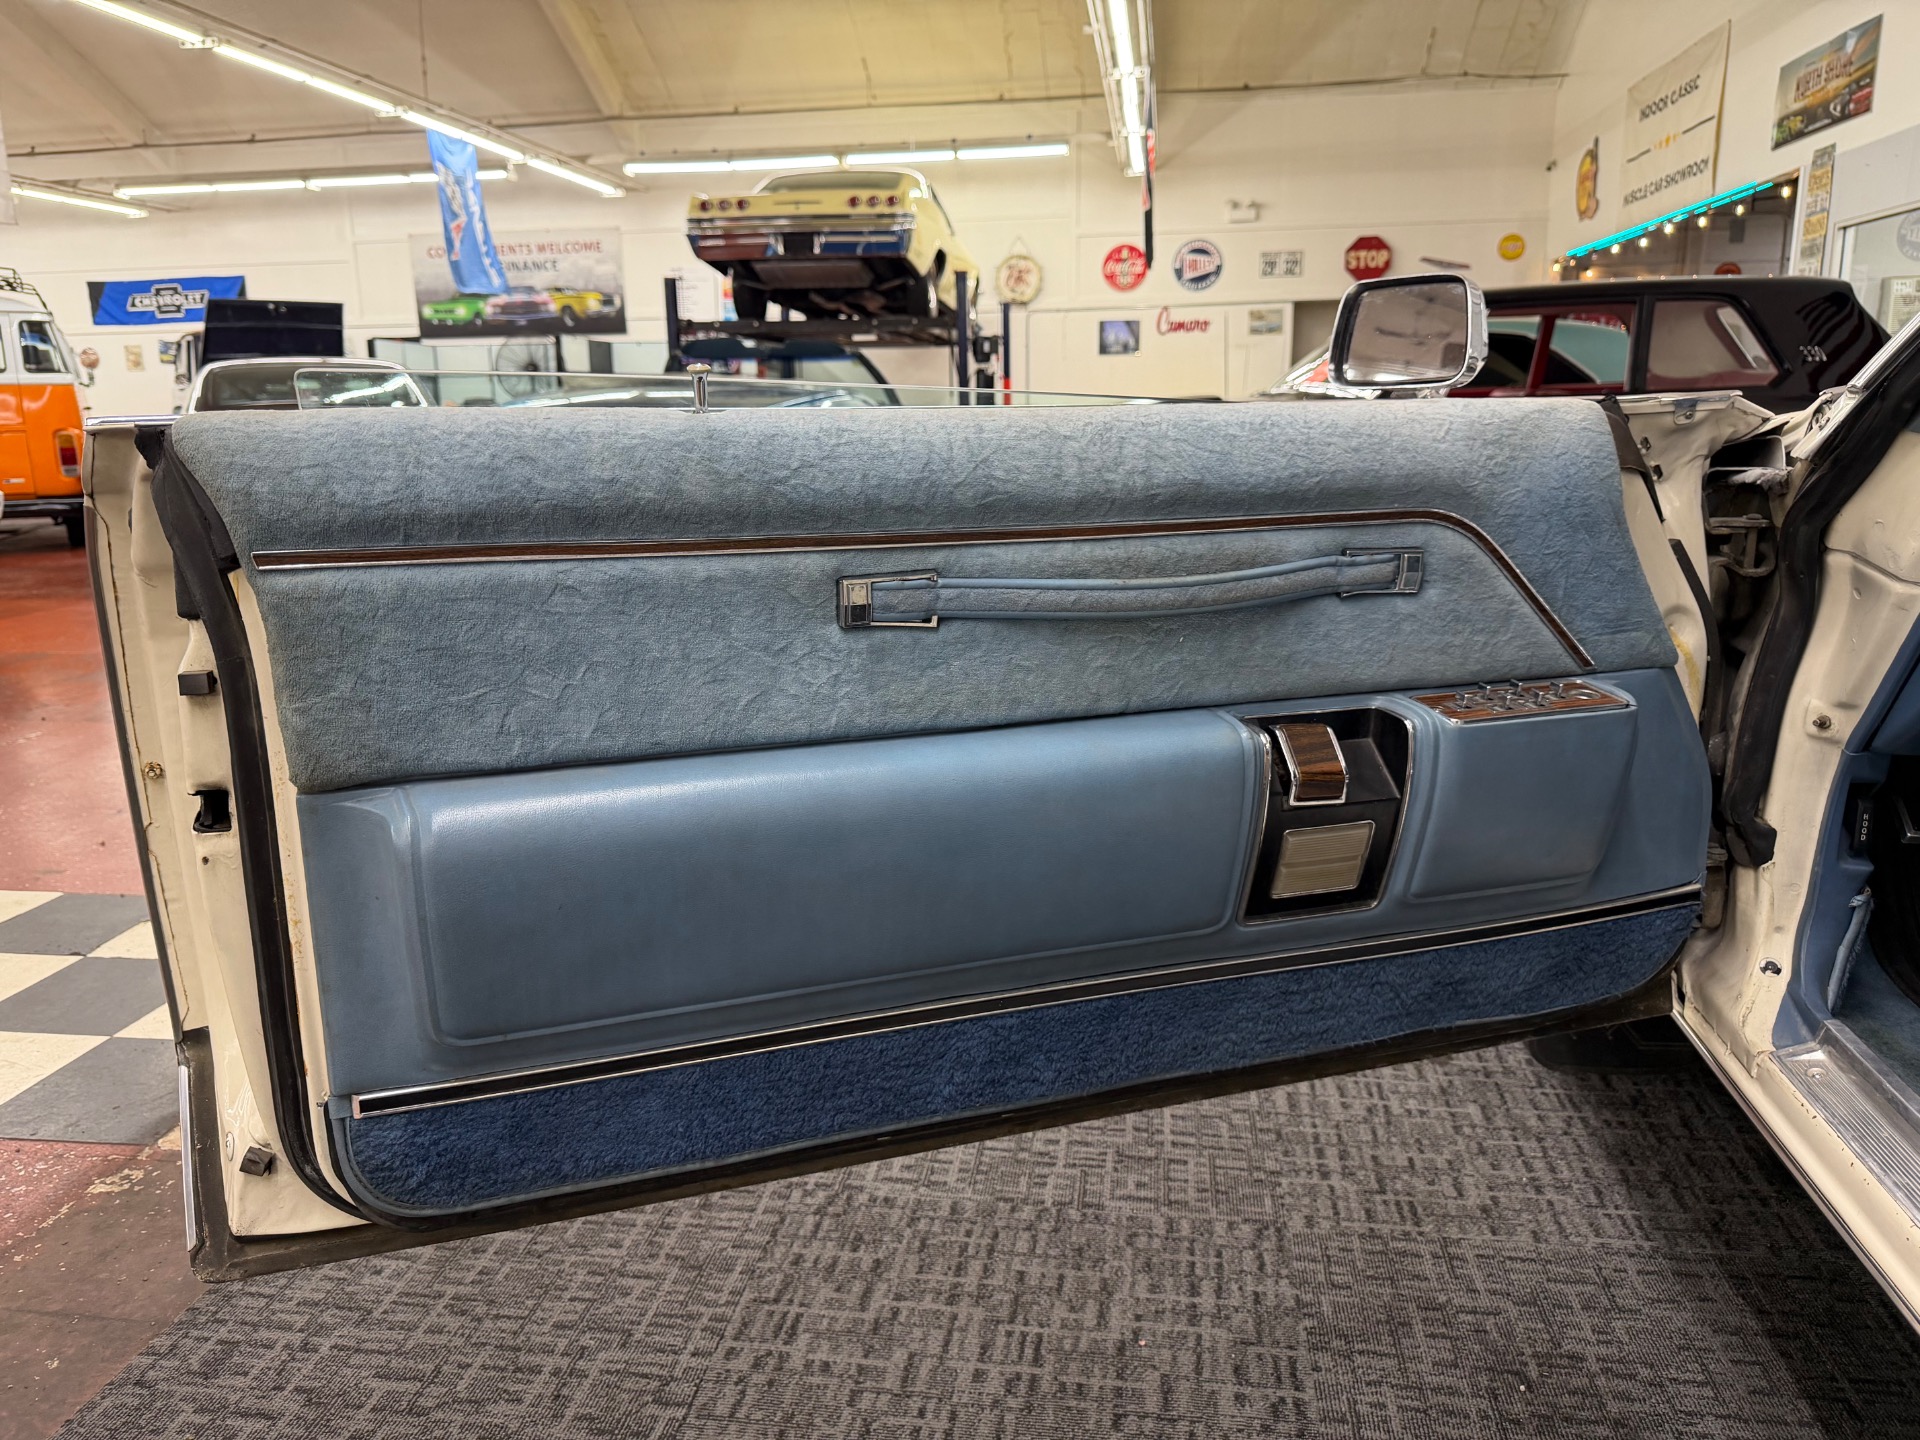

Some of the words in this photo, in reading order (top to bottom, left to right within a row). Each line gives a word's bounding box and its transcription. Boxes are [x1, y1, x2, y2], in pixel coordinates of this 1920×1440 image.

[1670, 74, 1700, 105] CLASSIC
[535, 240, 603, 255] WELCOME
[1347, 250, 1389, 269] STOP
[134, 293, 203, 309] CHEVROLET
[1156, 305, 1211, 335] Camaro
[1799, 345, 1827, 361] 330
[1860, 813, 1869, 841] HOOD
